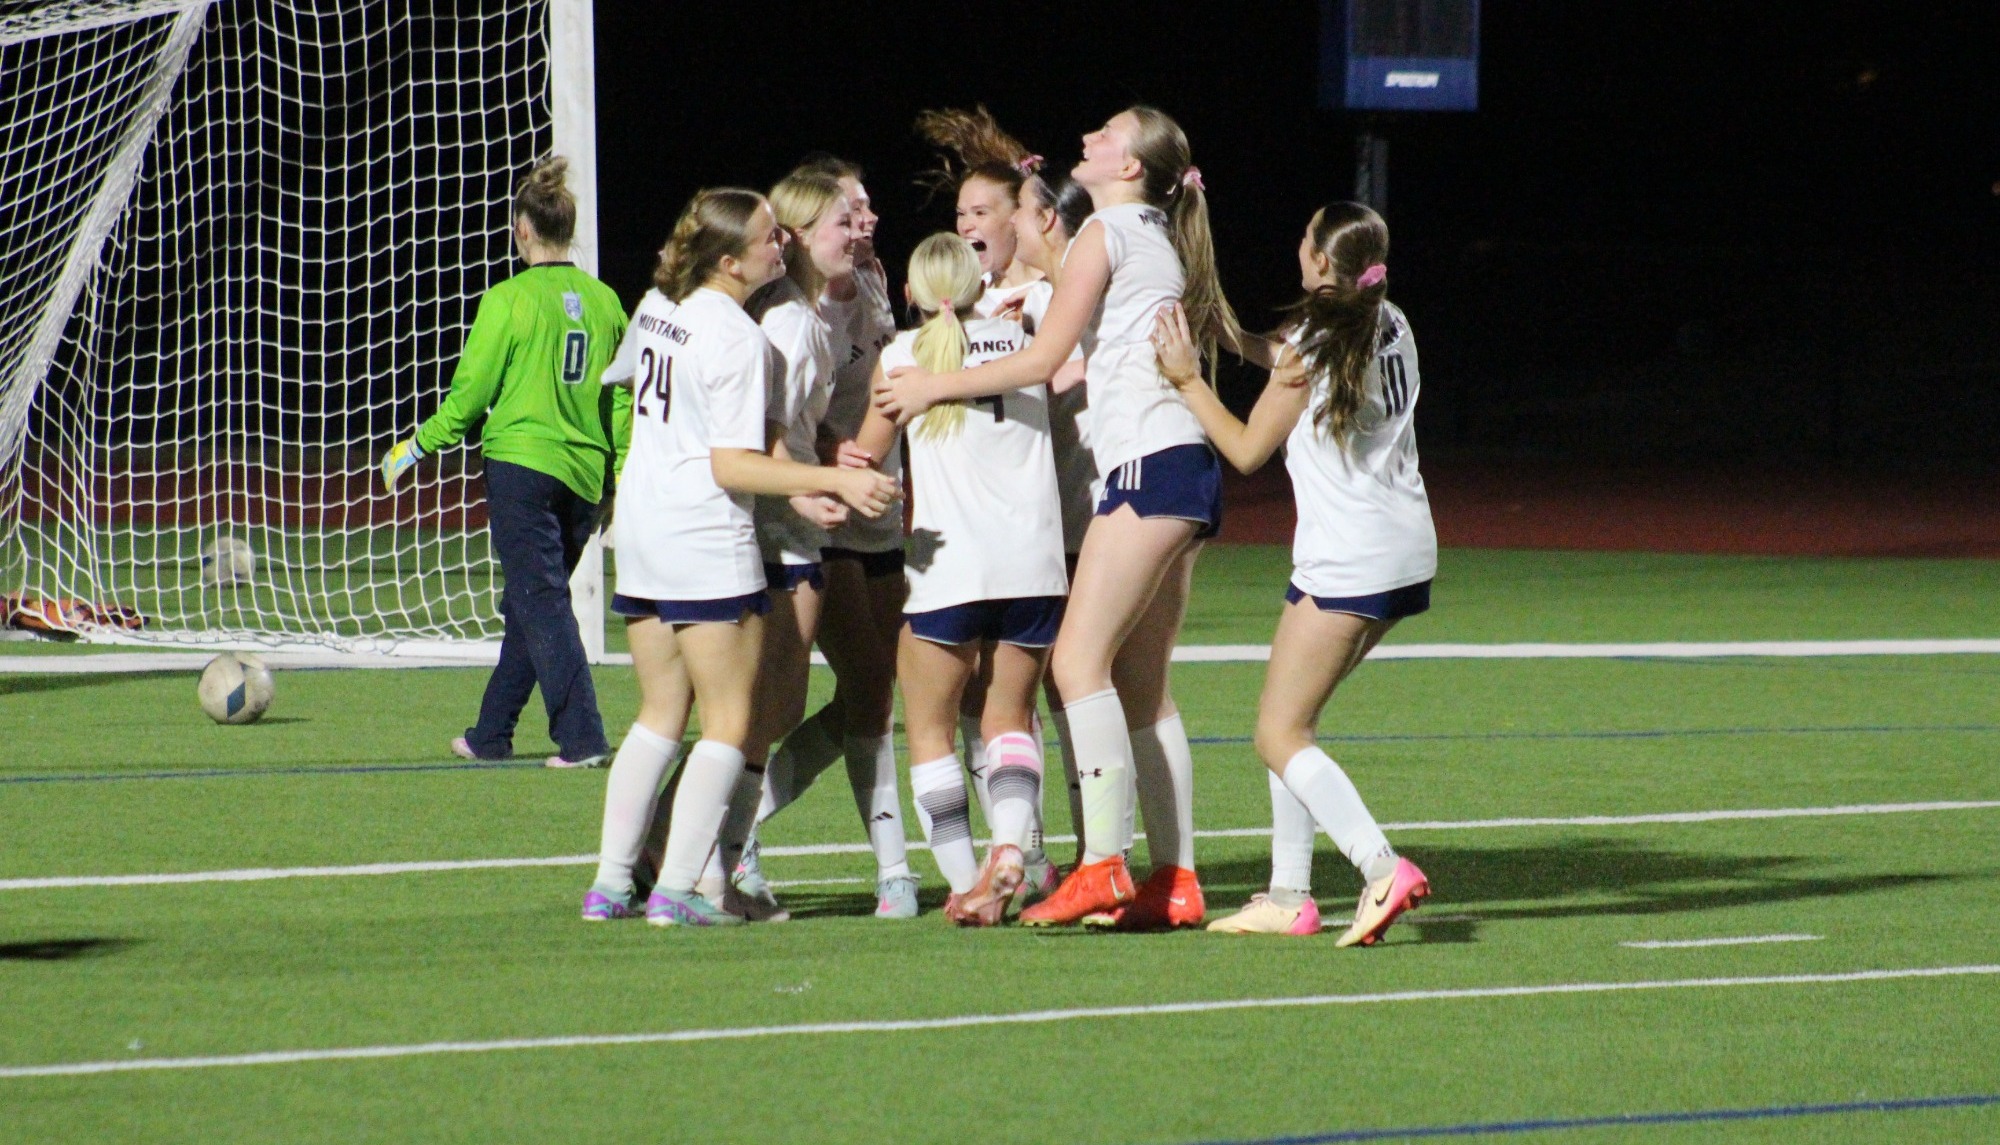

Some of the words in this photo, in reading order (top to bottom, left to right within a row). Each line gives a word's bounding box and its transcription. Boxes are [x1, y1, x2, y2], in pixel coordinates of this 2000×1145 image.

[638, 313, 692, 346] MUSTANGS
[969, 339, 1015, 354] ANGS
[563, 330, 588, 384] 0
[638, 346, 673, 424] 24
